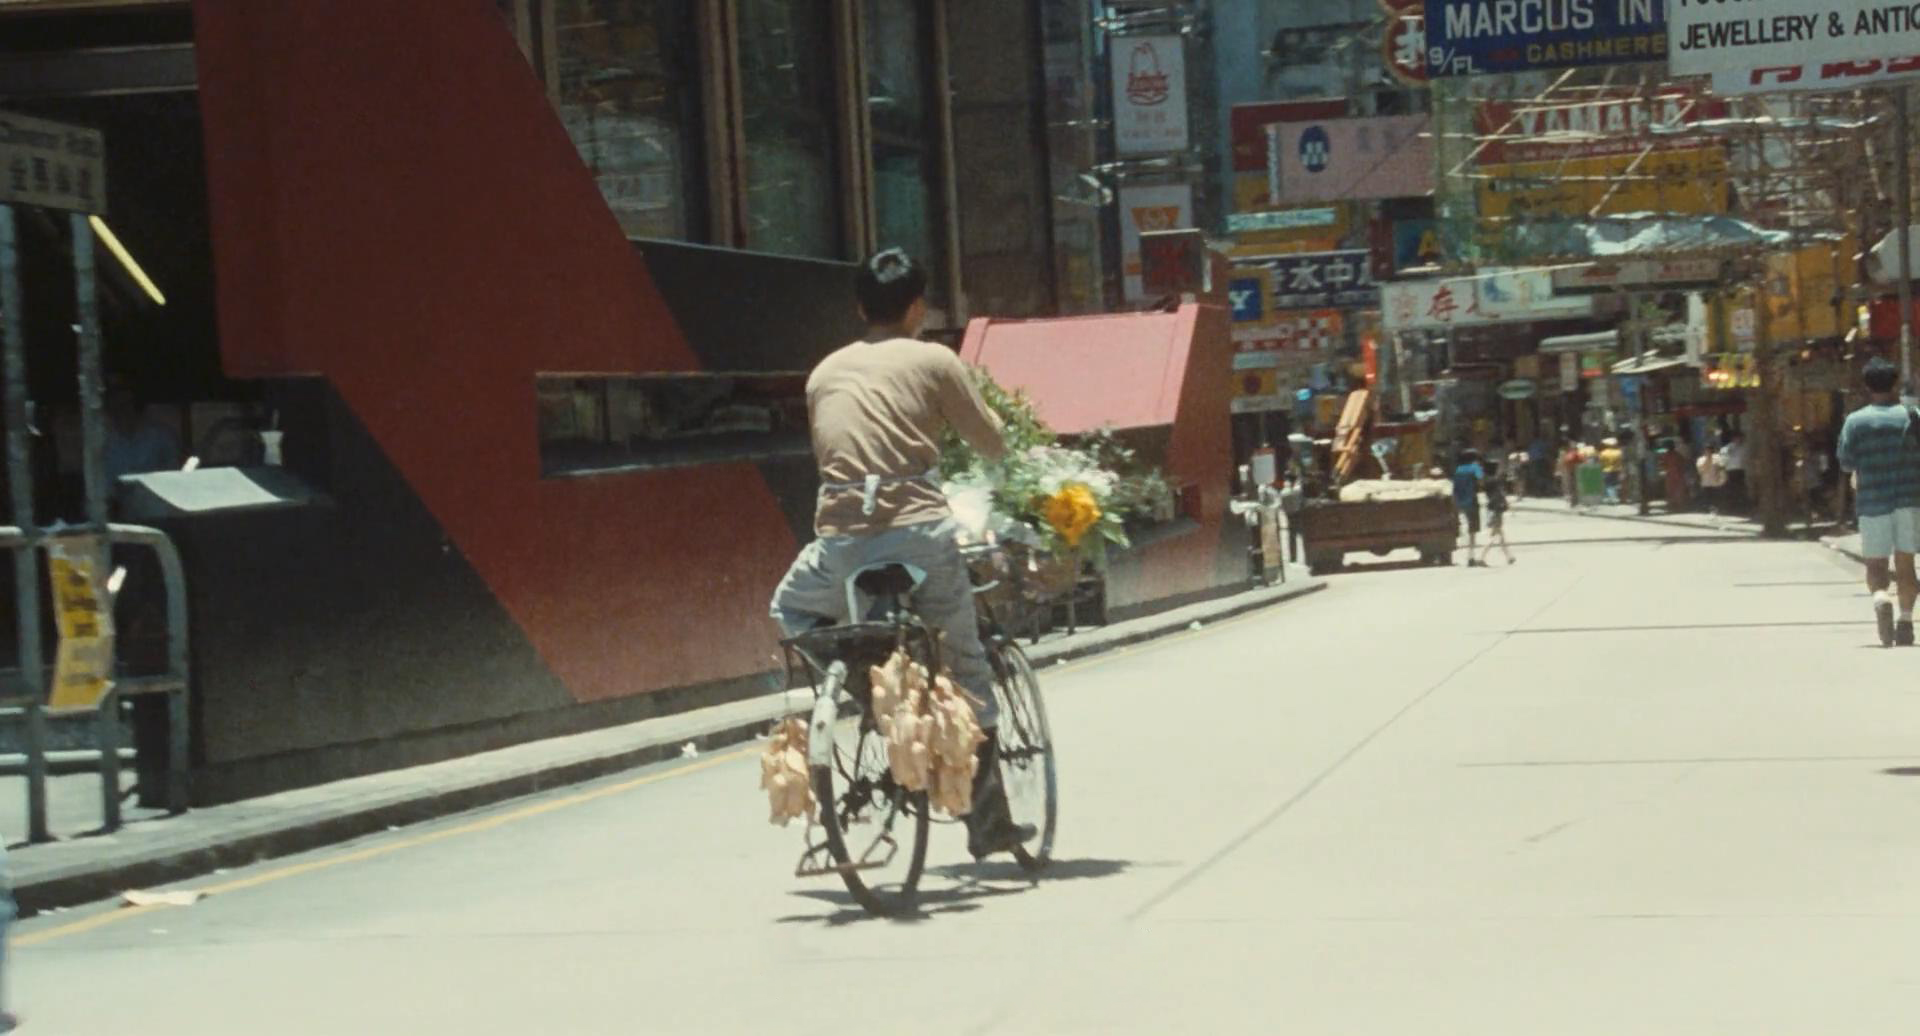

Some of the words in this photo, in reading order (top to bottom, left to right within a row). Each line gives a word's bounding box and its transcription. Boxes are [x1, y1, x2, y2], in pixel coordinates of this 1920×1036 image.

[1445, 0, 1594, 39] MARCUS
[1619, 0, 1667, 25] IN
[1680, 13, 1818, 50] JEWELLERY
[1828, 11, 1845, 37] &
[1527, 34, 1666, 63] CASHMERE
